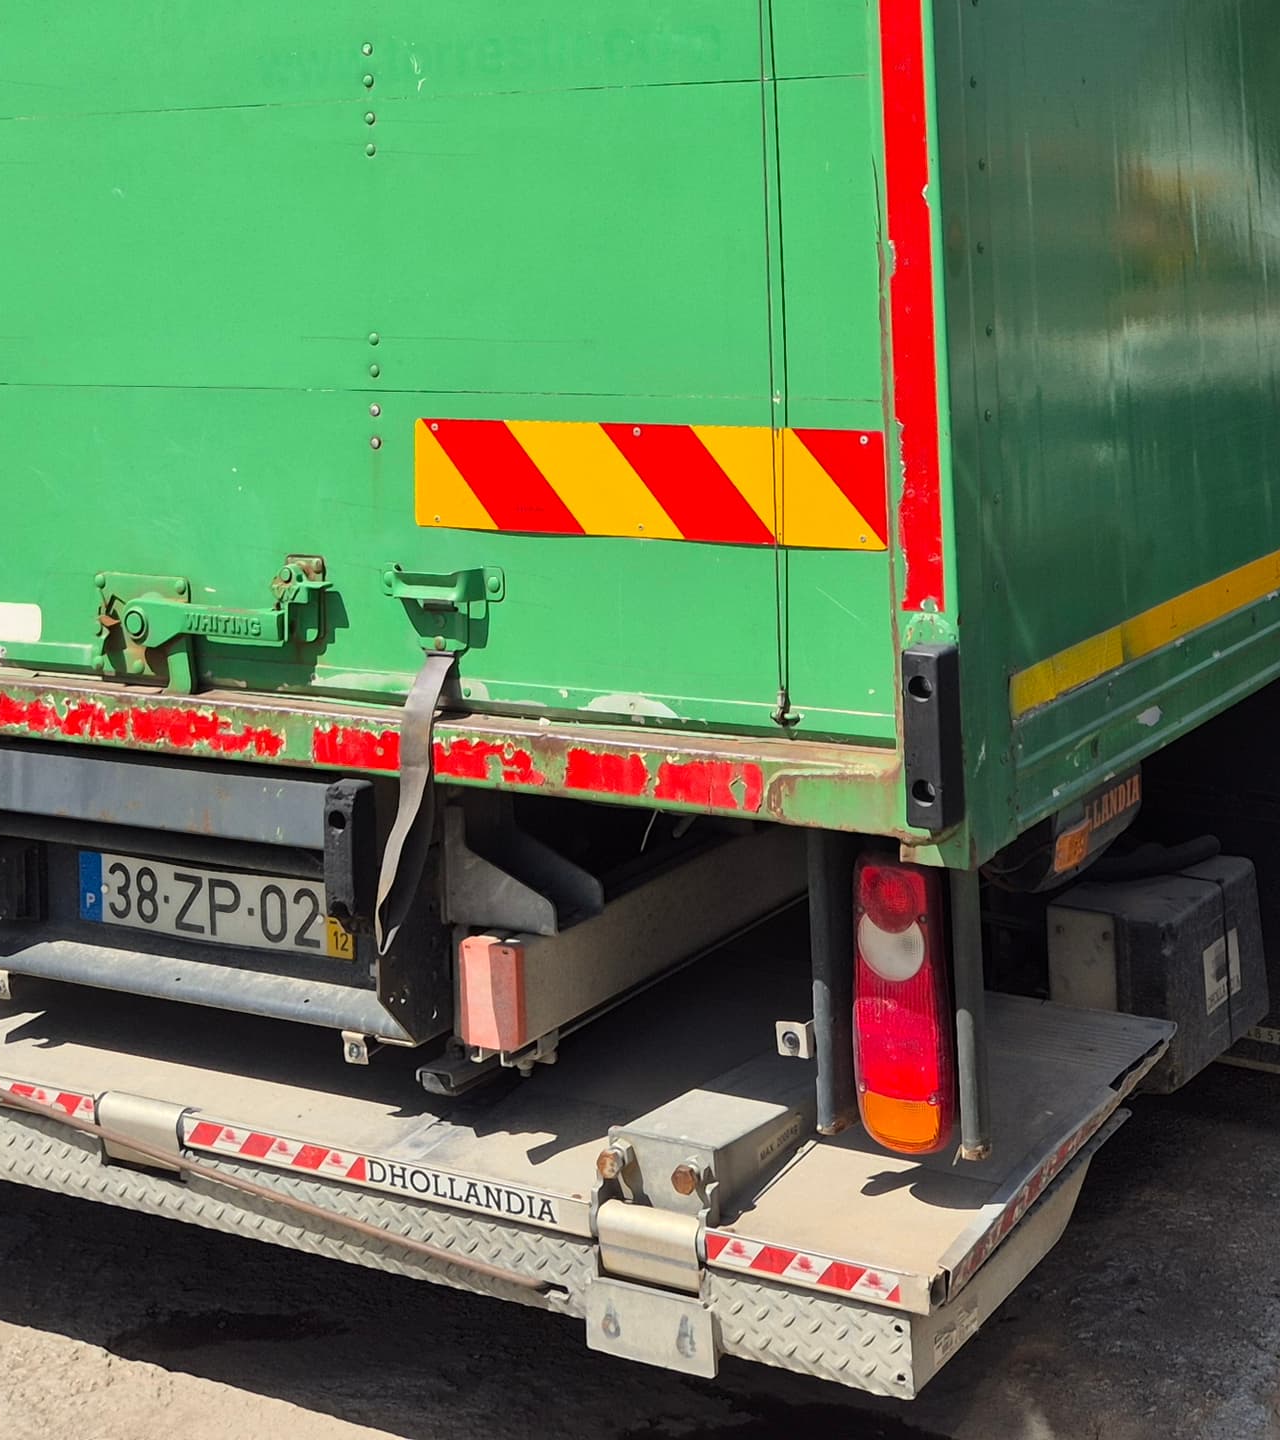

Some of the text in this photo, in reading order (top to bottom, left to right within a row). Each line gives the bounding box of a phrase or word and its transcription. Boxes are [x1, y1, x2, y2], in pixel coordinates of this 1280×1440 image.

[185, 612, 262, 637] WHITING
[85, 892, 96, 908] P
[333, 931, 350, 952] 12
[367, 1159, 559, 1225] DHOLLANDIA
